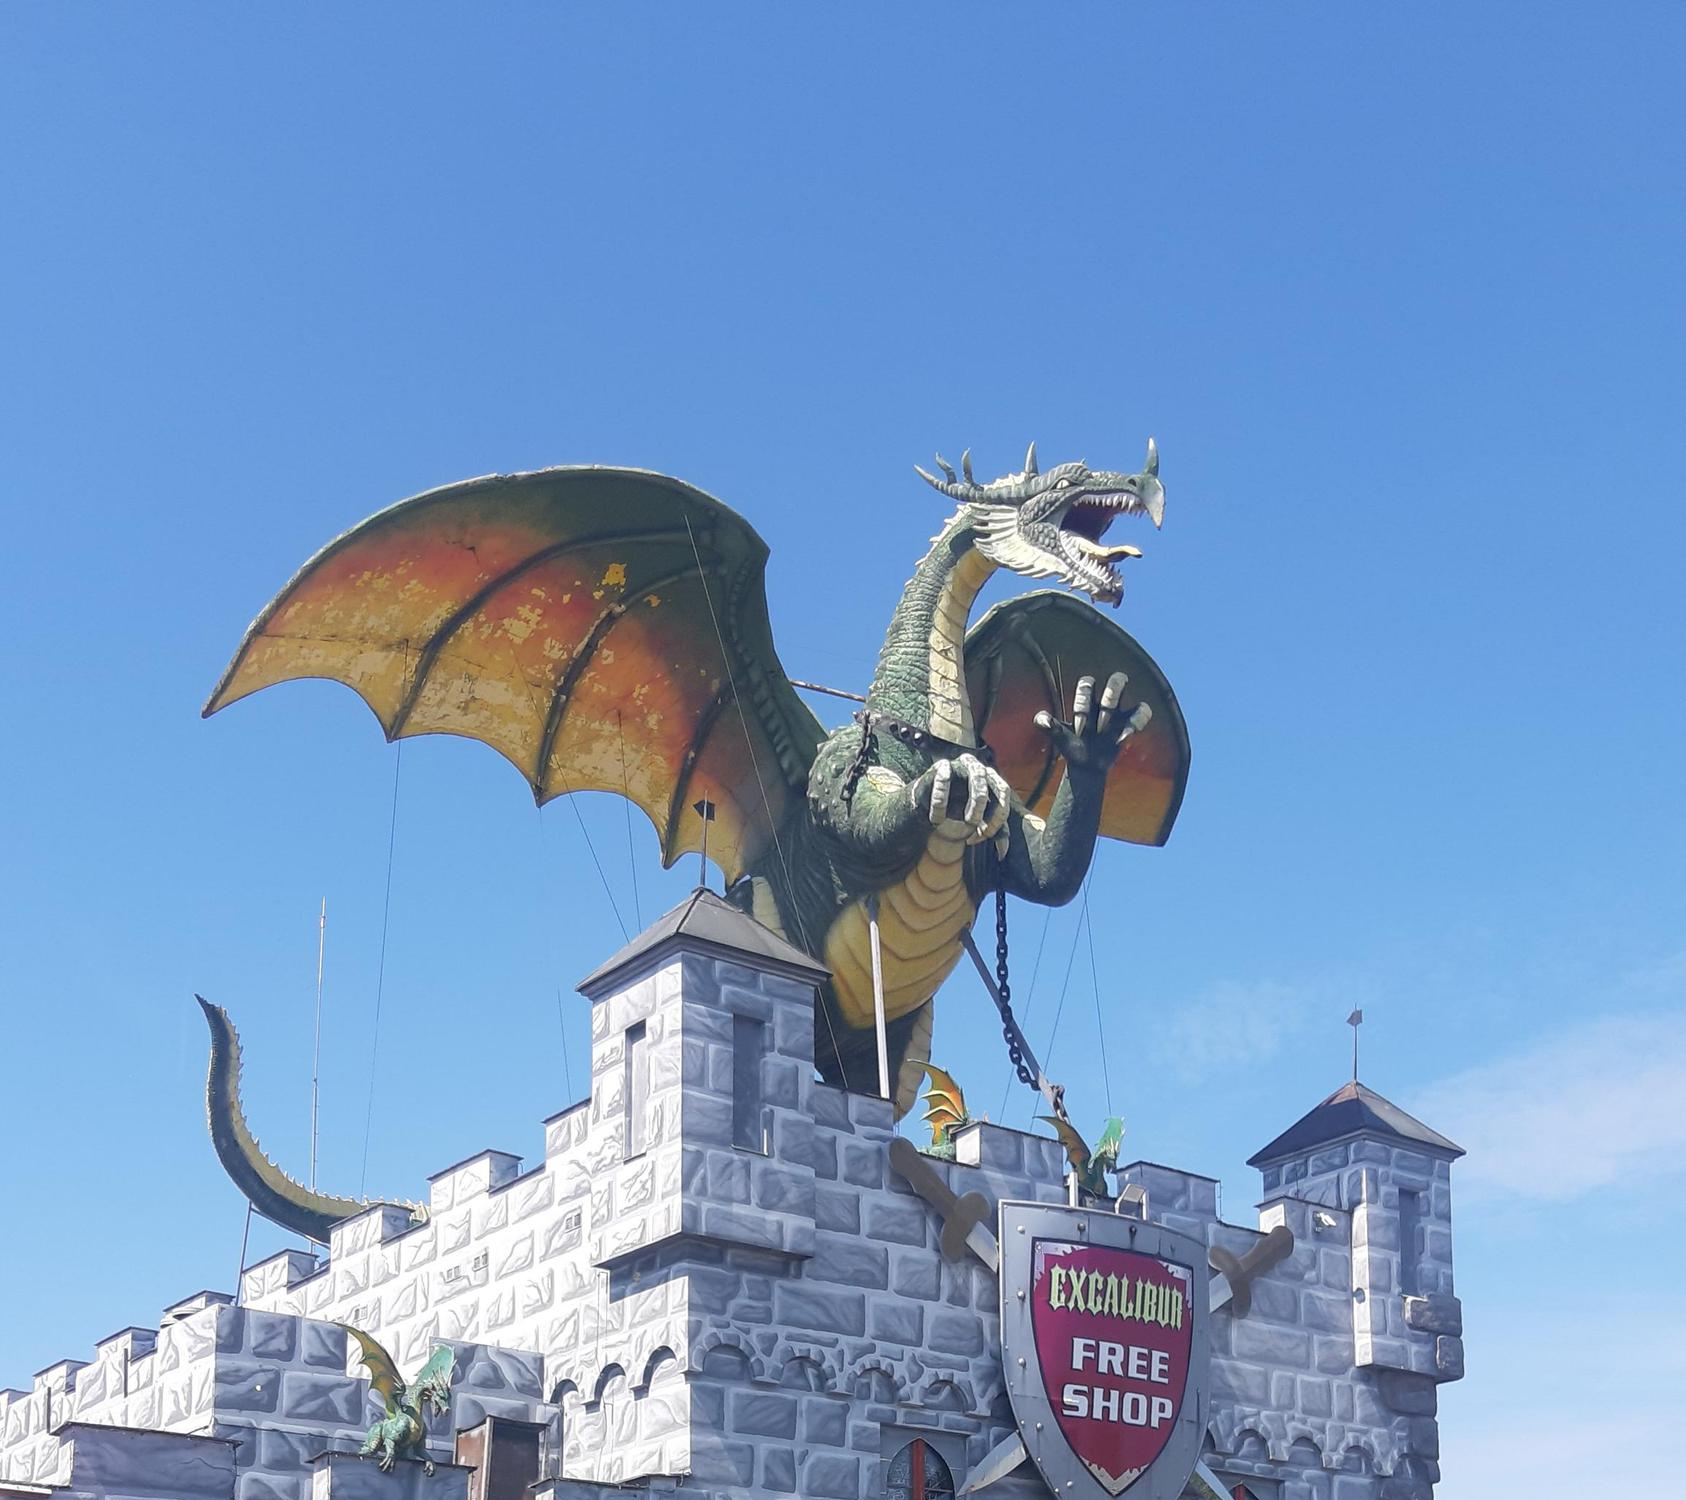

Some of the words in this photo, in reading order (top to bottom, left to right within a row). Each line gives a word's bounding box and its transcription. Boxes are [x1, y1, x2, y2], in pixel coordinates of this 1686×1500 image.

[1049, 1263, 1183, 1330] EXCALIBUR
[1071, 1337, 1169, 1384] FREE
[1062, 1384, 1174, 1429] SHOP
